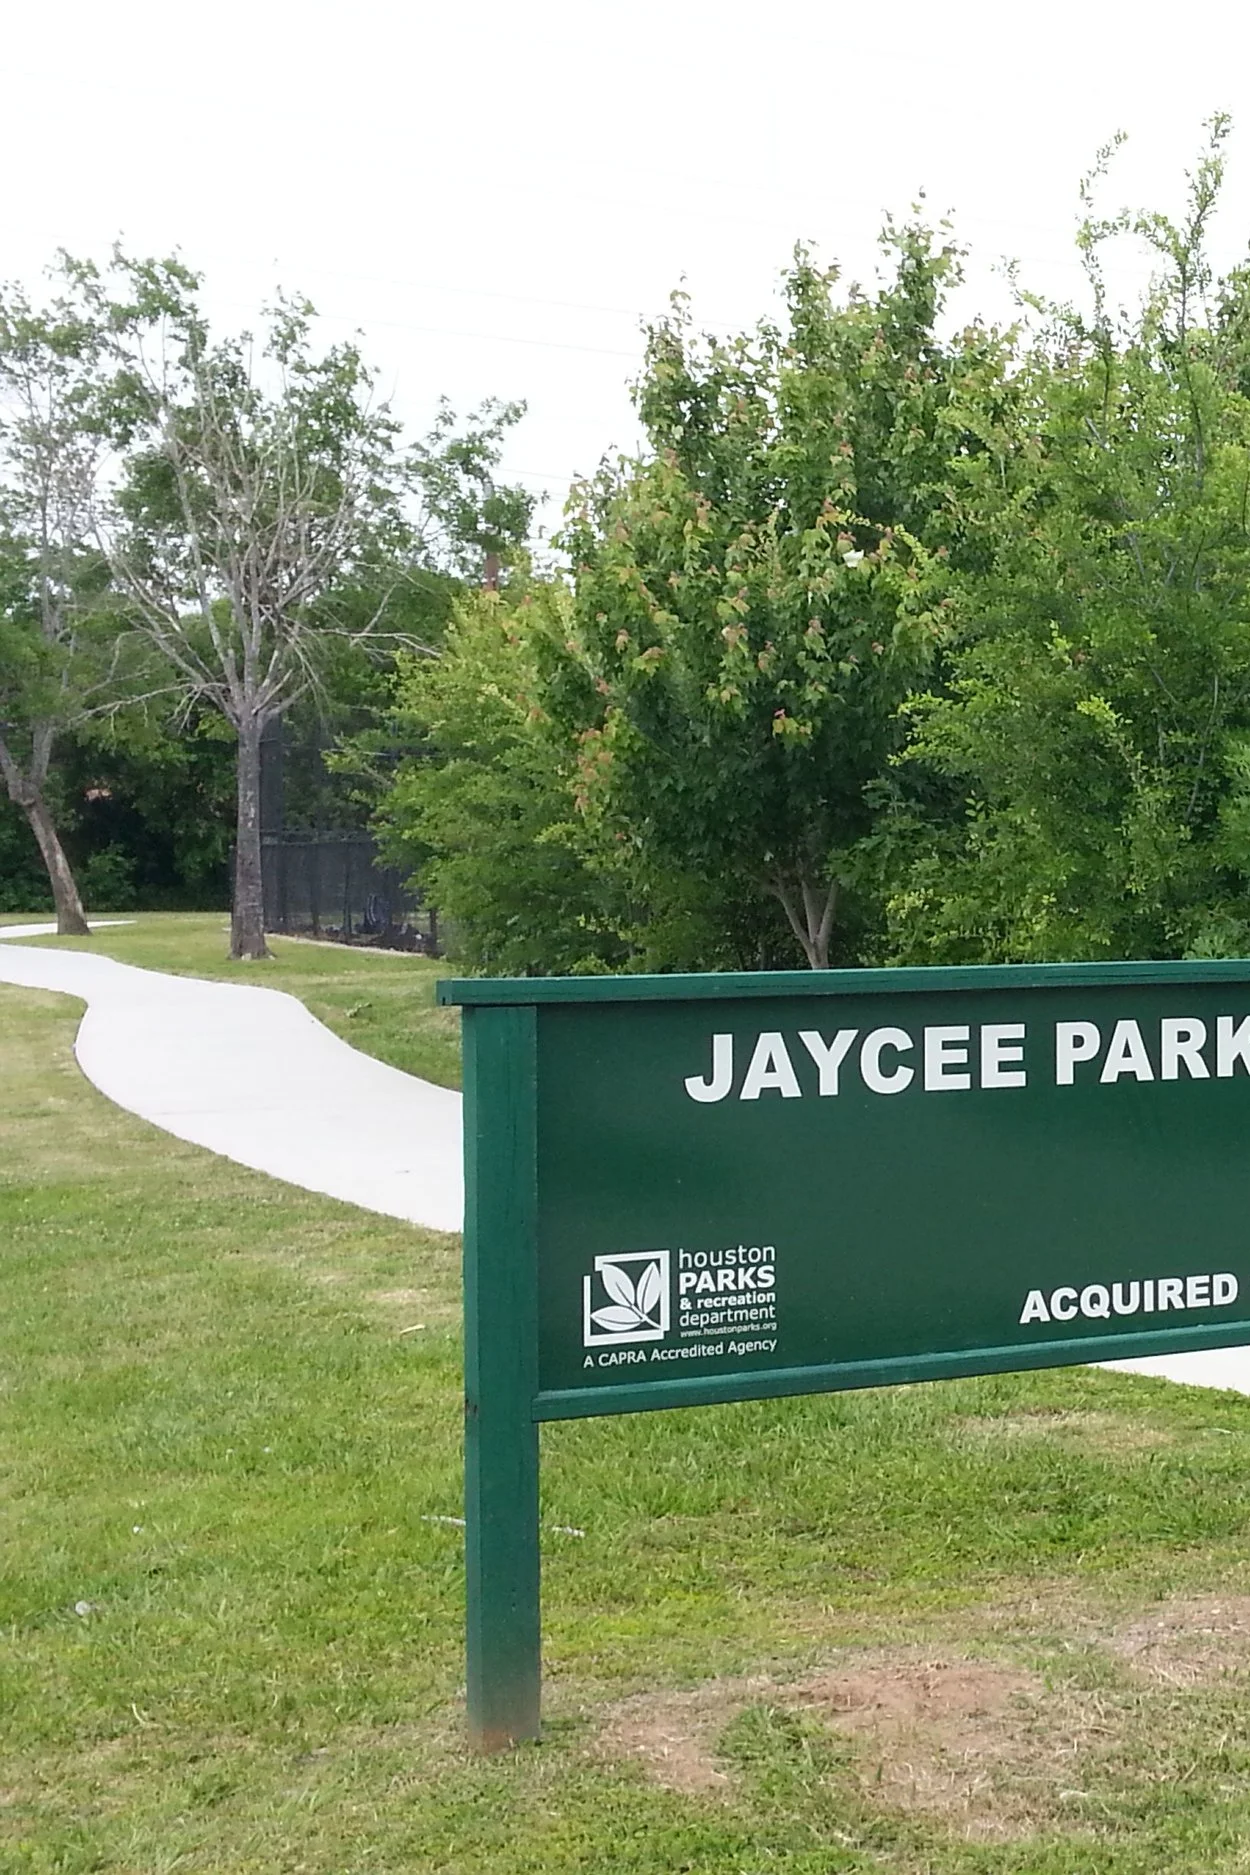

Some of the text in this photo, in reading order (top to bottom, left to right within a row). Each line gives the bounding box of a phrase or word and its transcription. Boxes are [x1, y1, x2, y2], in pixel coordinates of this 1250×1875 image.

[684, 1023, 1027, 1102] JAYCEE
[679, 1245, 776, 1269] houston
[679, 1265, 776, 1295] PARKS
[680, 1291, 776, 1311] & recreation
[1019, 1273, 1239, 1324] ACQUIRED
[679, 1305, 776, 1328] department
[680, 1321, 778, 1338] www.houstonparks.org
[583, 1338, 778, 1368] A CAPRA Accredited Agency
